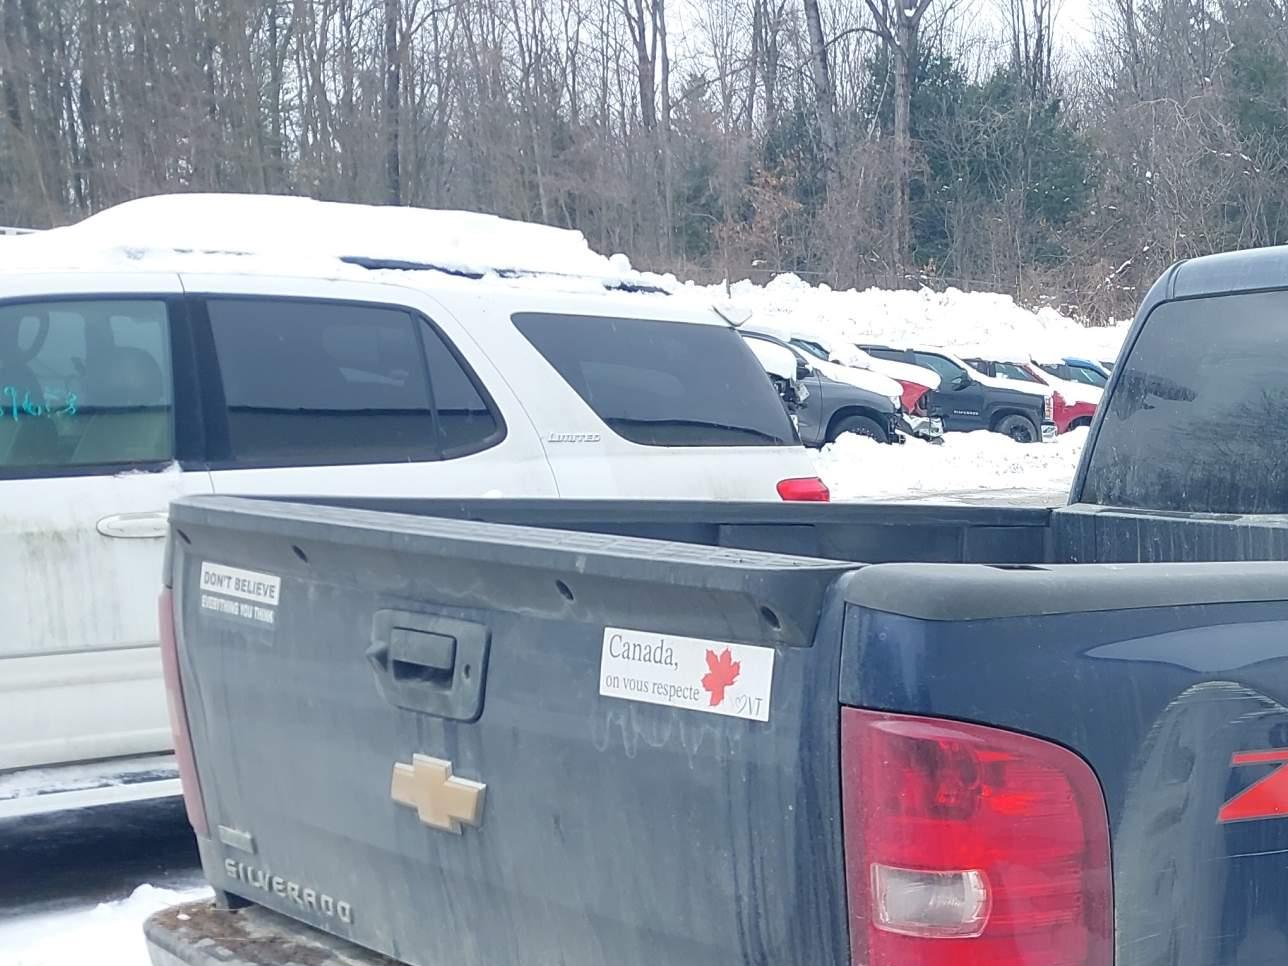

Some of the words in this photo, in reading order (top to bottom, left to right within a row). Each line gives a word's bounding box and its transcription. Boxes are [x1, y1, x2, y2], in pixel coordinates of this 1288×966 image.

[548, 433, 601, 442] LIMITED
[204, 571, 232, 588] DON'T
[234, 577, 276, 599] BELIEVE
[609, 633, 679, 671] Canada,
[606, 674, 620, 688] on
[623, 677, 649, 693] vous
[651, 681, 700, 701] respecte
[224, 857, 352, 923] SILVERADO
